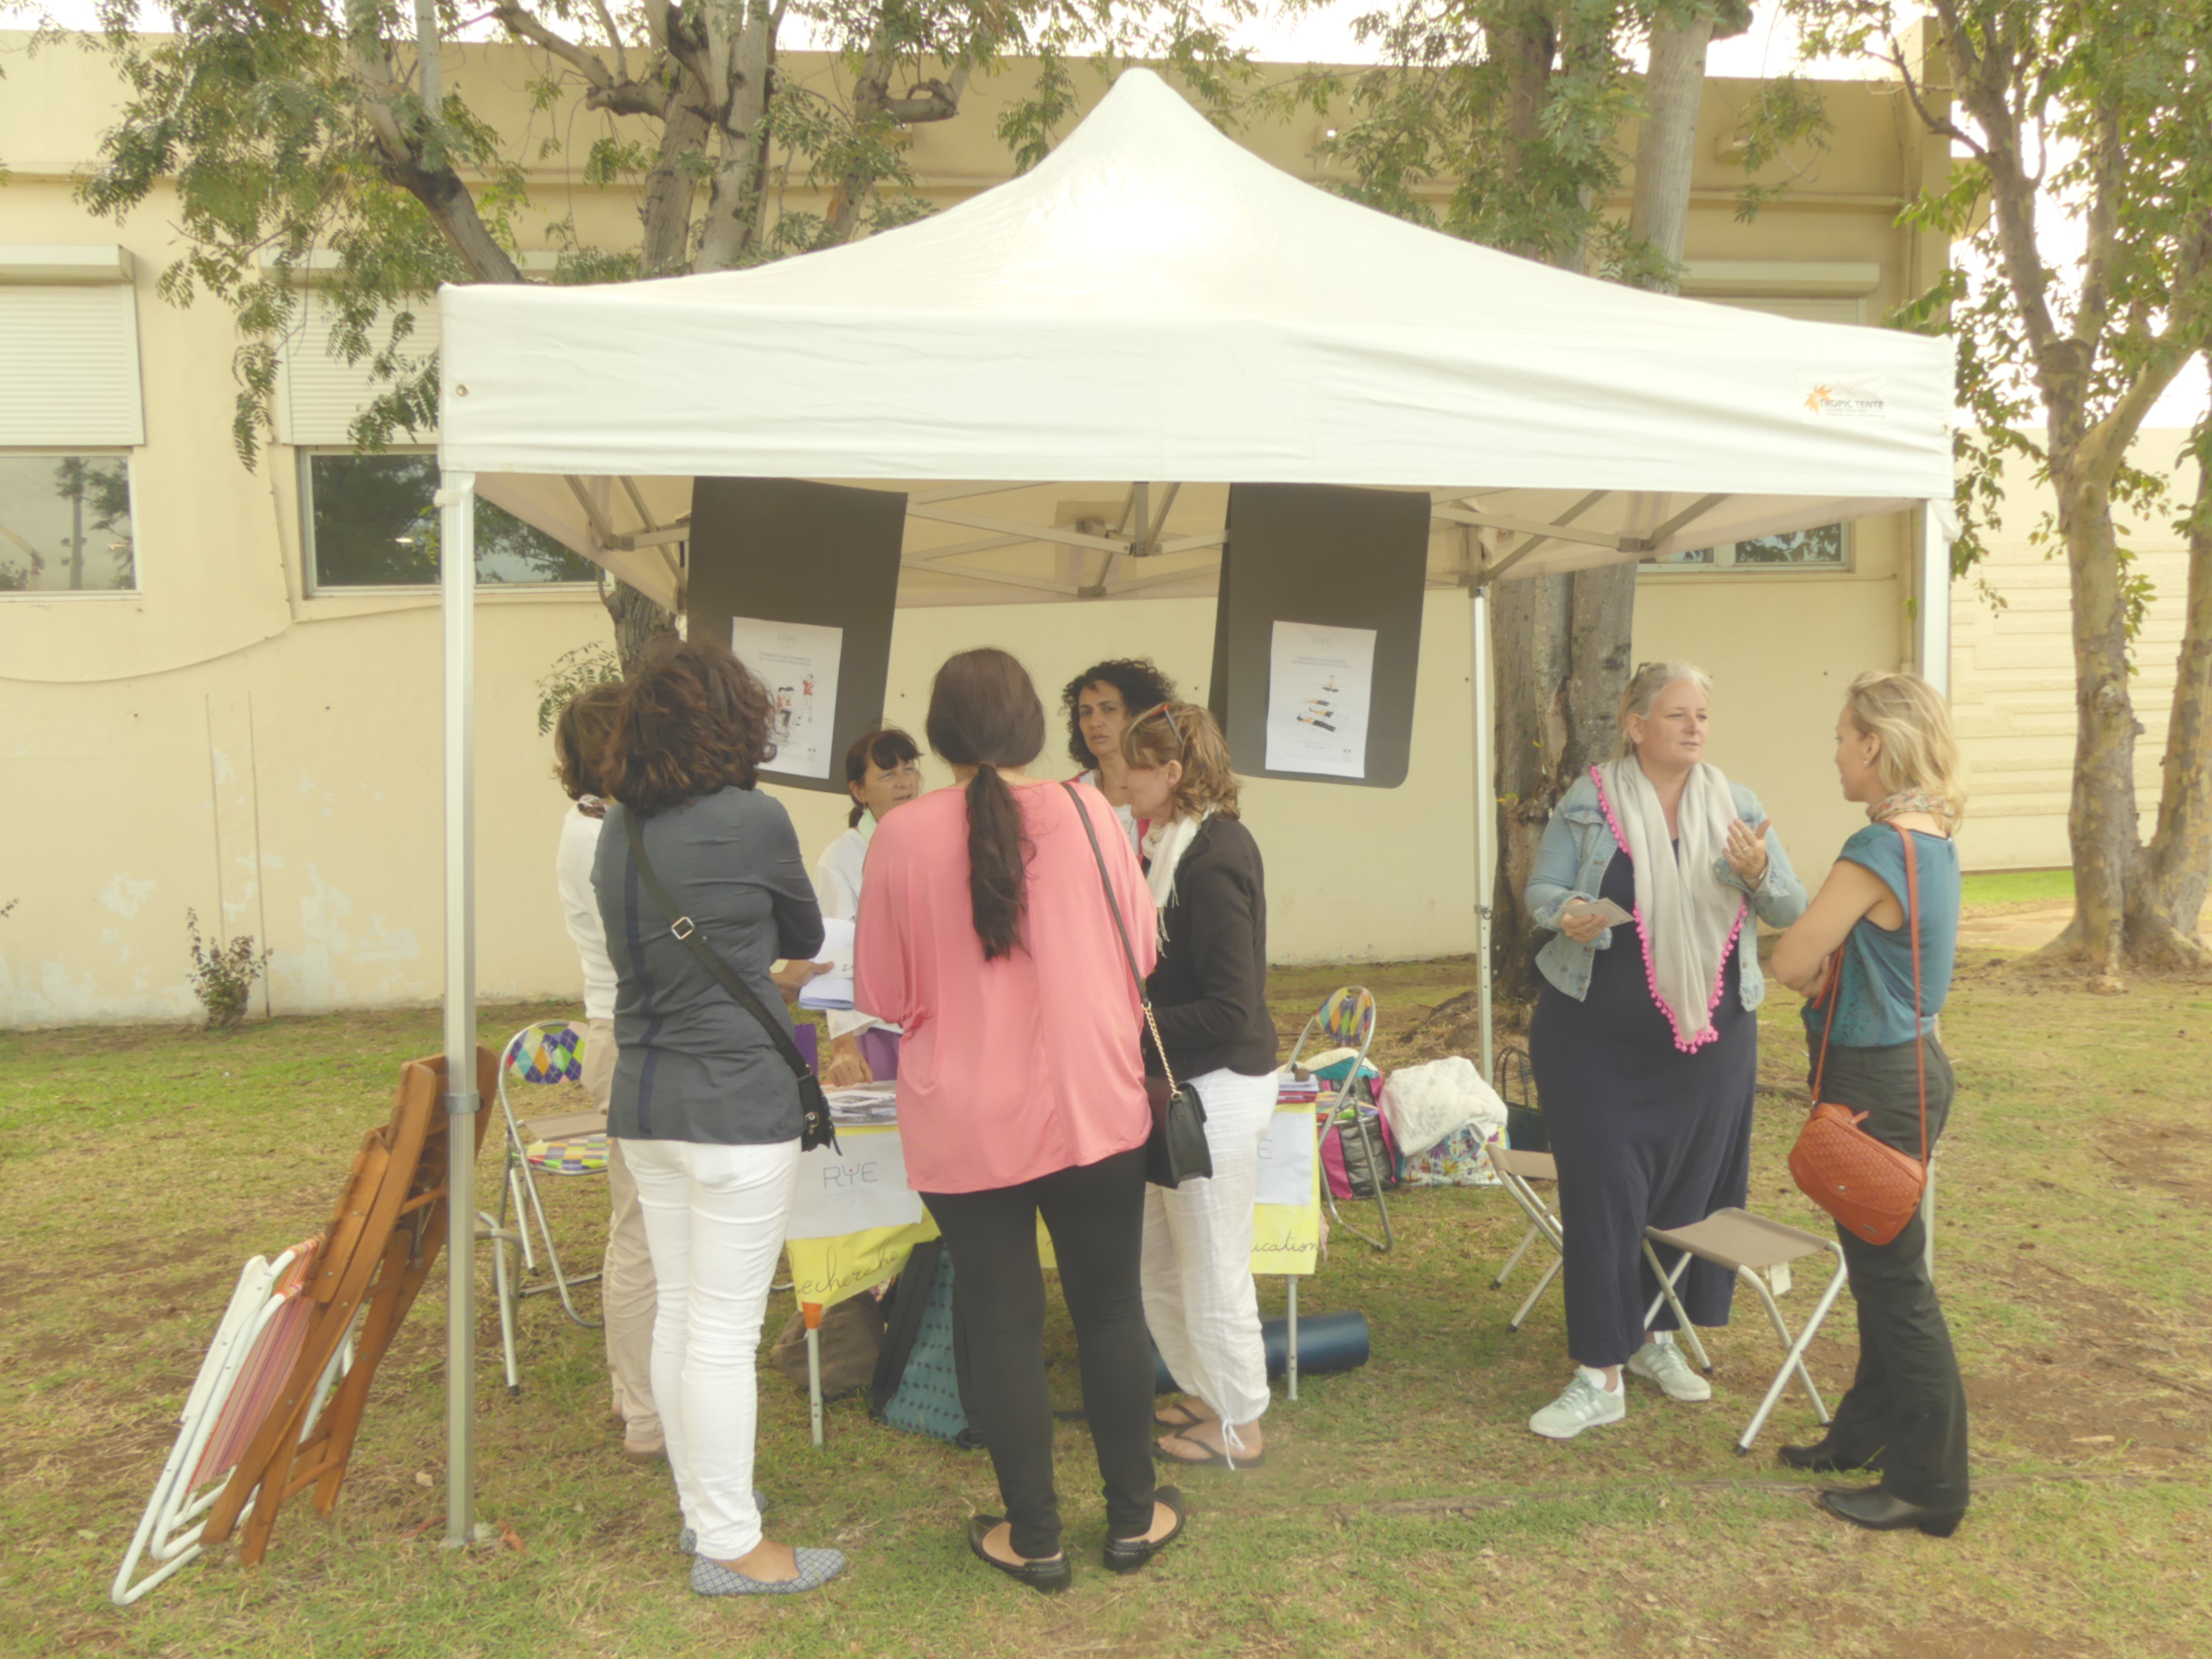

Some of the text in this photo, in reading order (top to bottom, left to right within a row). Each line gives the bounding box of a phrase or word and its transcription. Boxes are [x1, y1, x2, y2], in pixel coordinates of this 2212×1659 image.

[1819, 399, 1884, 409] TROPIC TENTE
[777, 633, 799, 645] RYE
[1311, 637, 1332, 648] RYE
[822, 1162, 878, 1189] RYE
